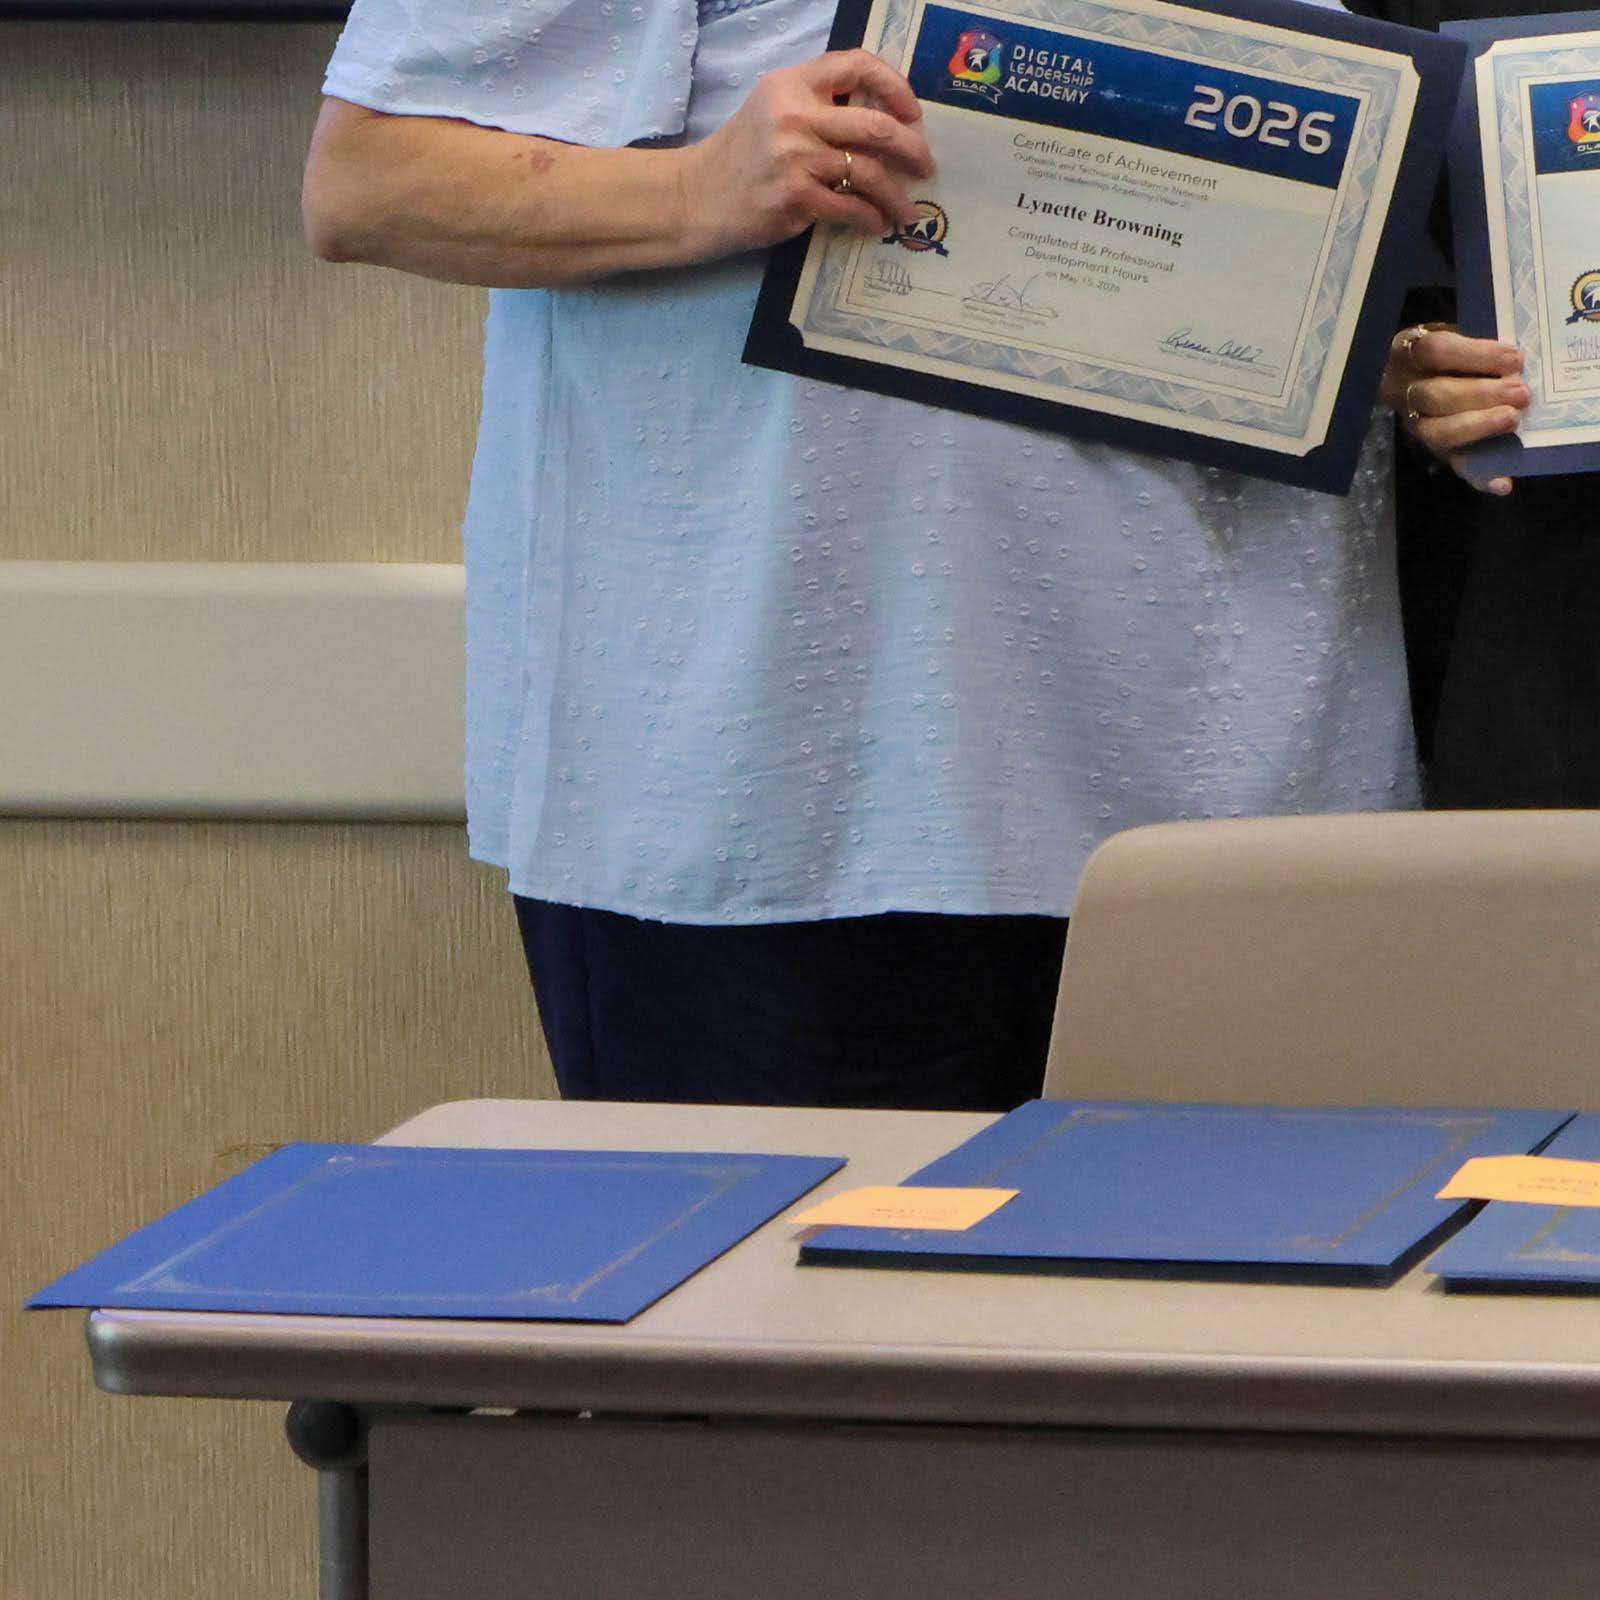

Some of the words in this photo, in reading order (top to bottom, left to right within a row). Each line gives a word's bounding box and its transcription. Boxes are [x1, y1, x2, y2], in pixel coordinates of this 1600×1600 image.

[1010, 62, 1094, 87] LEADERSHIP
[1013, 45, 1094, 75] DIGITAL
[1004, 76, 1089, 104] ACADEMY
[1185, 85, 1335, 154] 2026
[1013, 133, 1092, 160] Certificate
[1095, 152, 1114, 164] of
[1115, 155, 1218, 189] Achievement
[1017, 193, 1088, 221] Lynette
[1093, 209, 1185, 248] Browning
[1008, 226, 1079, 251] Completed
[1082, 242, 1096, 255] 86
[1100, 247, 1175, 273] Professional
[1025, 247, 1109, 274] Development
[1113, 267, 1149, 283] Hours
[1060, 273, 1079, 284] May
